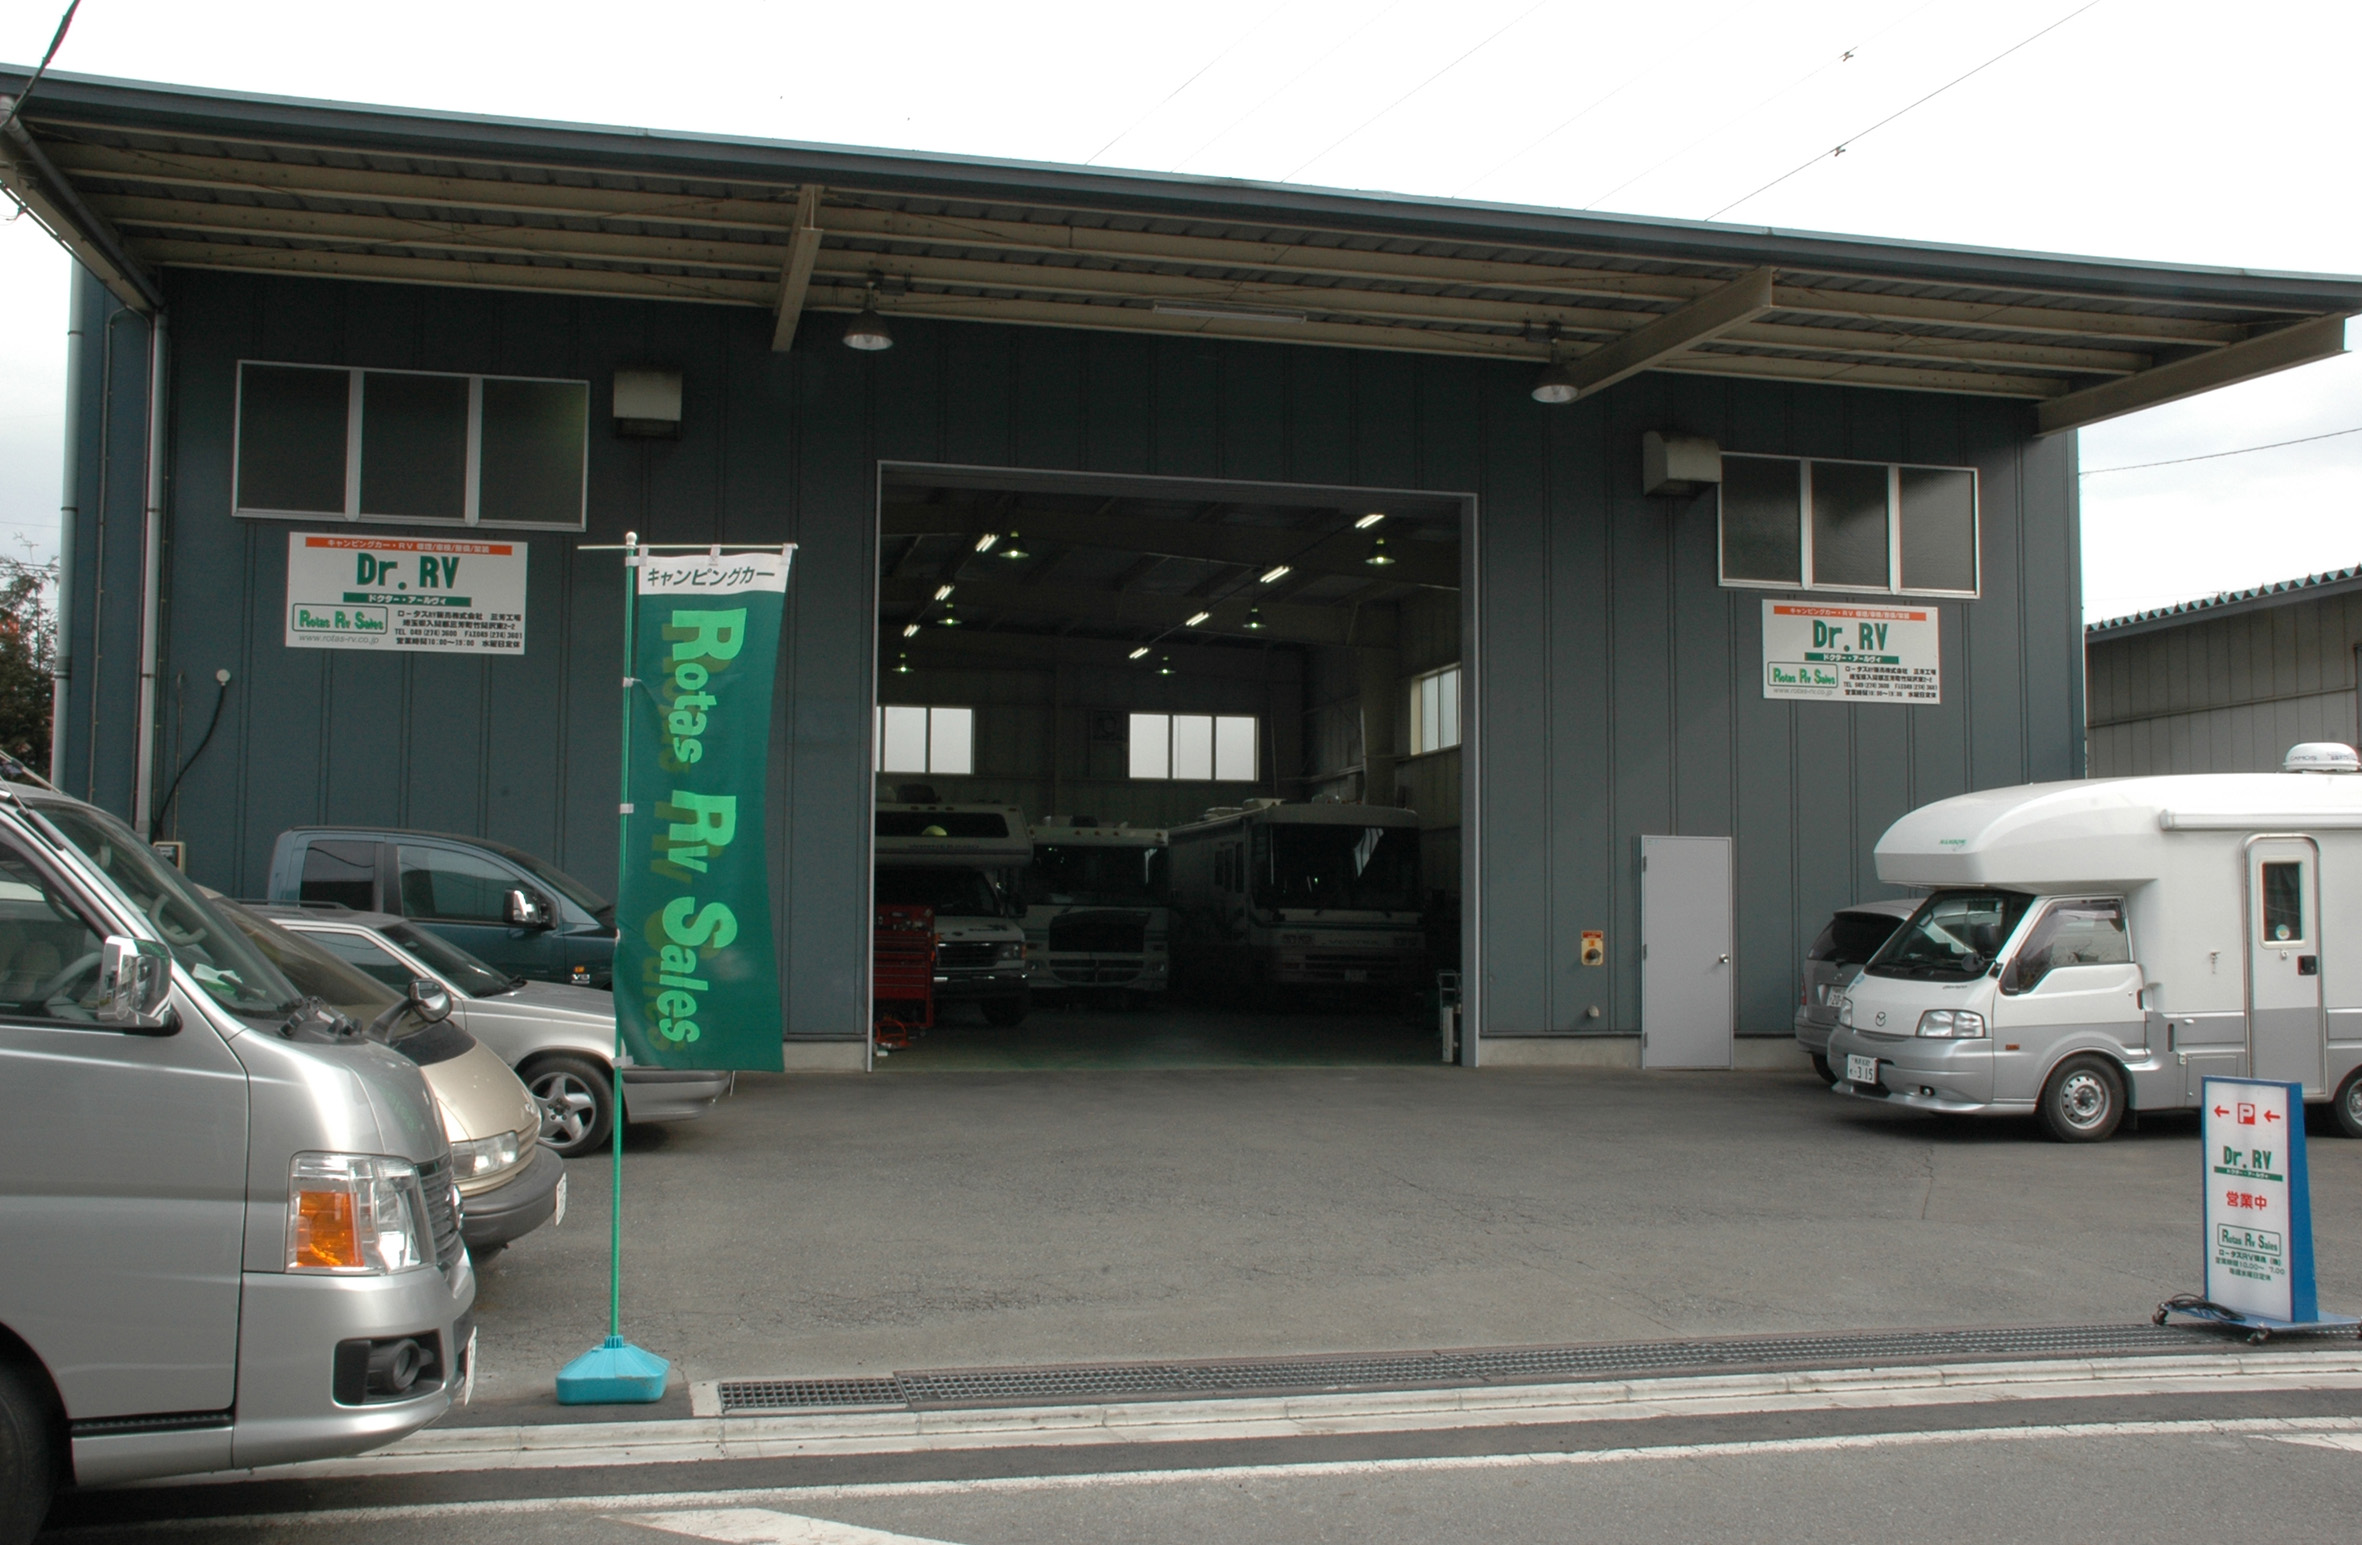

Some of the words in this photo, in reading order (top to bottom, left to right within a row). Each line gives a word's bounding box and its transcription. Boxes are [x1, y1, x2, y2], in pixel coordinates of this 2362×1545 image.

[357, 553, 407, 590] Dr.
[419, 555, 460, 589] RV
[647, 566, 775, 587] キャンピングカー
[368, 594, 447, 606] ドクター・アールヴィ
[299, 609, 330, 628] Rotas
[335, 611, 351, 629] Rv
[354, 611, 384, 630] Sales
[298, 634, 380, 645] www.rotas-rv.co.jp
[394, 628, 406, 636] TEL
[1813, 619, 1850, 652] Dr.
[1859, 622, 1888, 651] RV
[668, 607, 748, 764] Rotas
[1773, 667, 1796, 683] Rotas
[1814, 668, 1836, 685] Sales
[668, 789, 737, 874] Rv
[656, 896, 738, 1044] Sales
[2239, 1104, 2255, 1124] P
[2222, 1145, 2248, 1170] Dr.
[2252, 1149, 2272, 1171] RV
[2226, 1190, 2267, 1211] 営業中
[2222, 1229, 2242, 1247] Rotas
[2258, 1234, 2279, 1253] Sales
